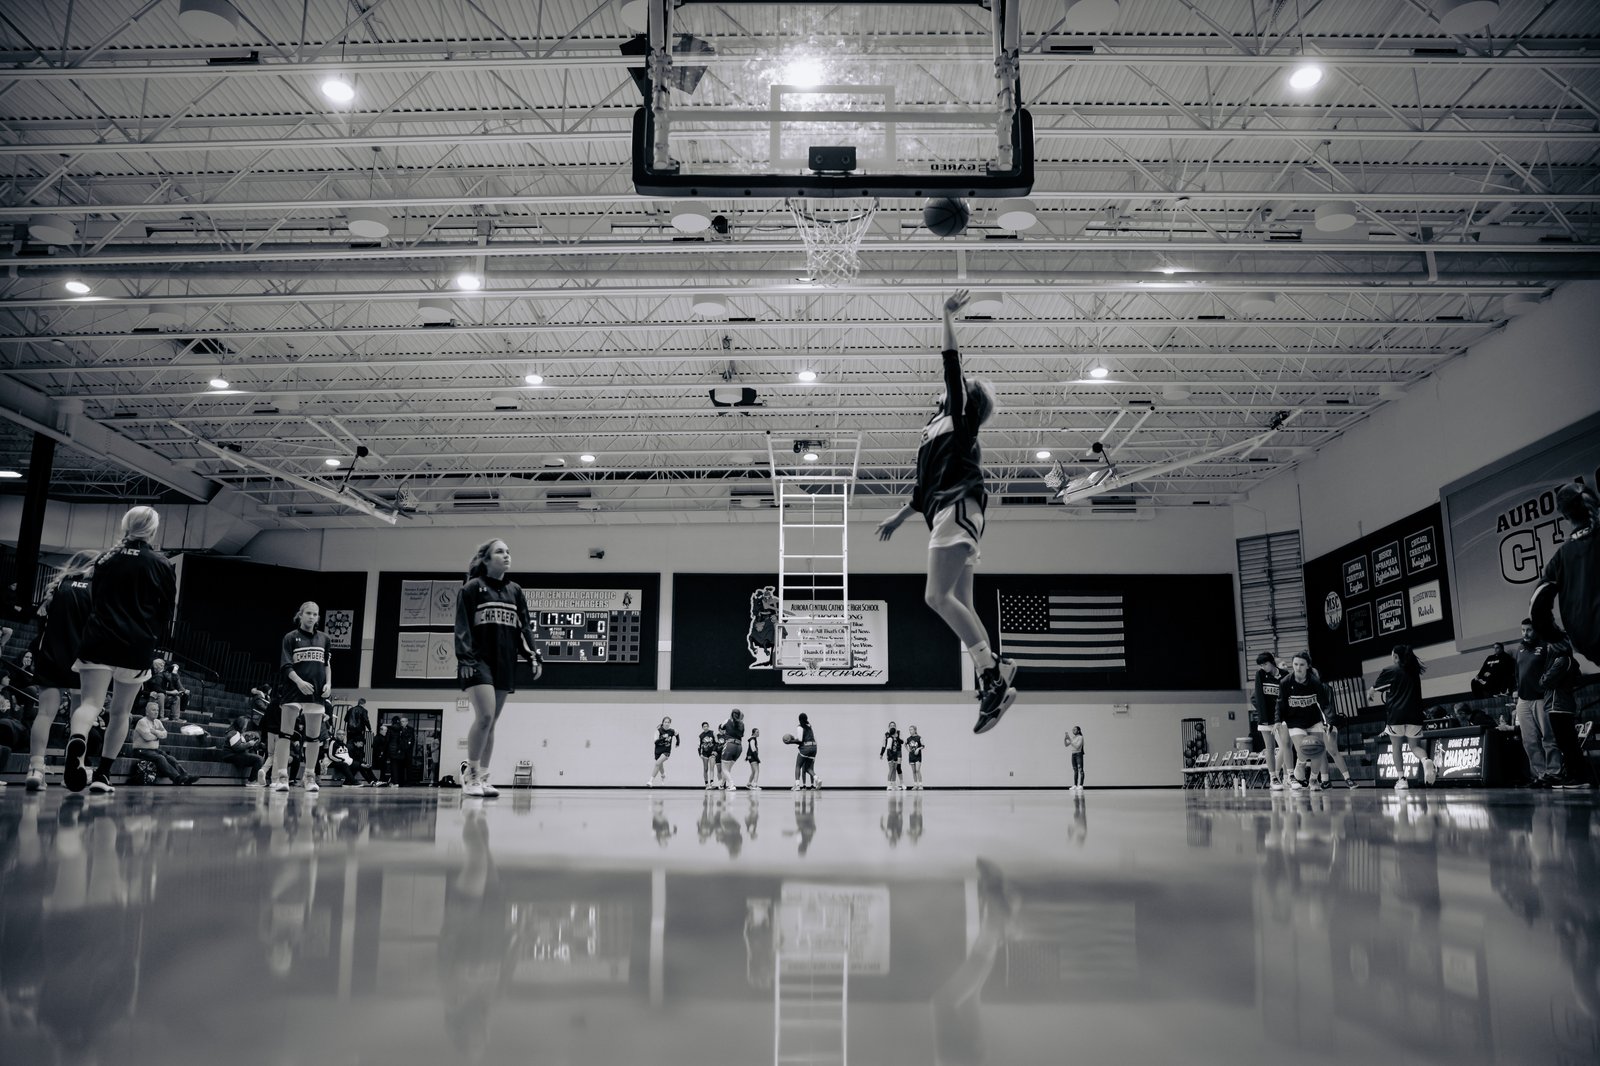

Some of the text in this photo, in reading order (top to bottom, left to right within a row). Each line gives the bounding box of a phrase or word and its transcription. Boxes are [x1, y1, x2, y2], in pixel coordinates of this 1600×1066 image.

[1411, 535, 1428, 548] CHICAGO
[1409, 542, 1431, 557] CHRISTIAN
[547, 590, 579, 600] CENTRAL
[580, 590, 616, 600] CATHOLIC
[527, 599, 609, 608] OME OF THE CHARGERS
[790, 603, 808, 611] AURORA
[808, 603, 827, 611] CENTRAL
[850, 603, 862, 611] HIGH
[862, 603, 880, 611] SCHOOL
[480, 610, 515, 624] CHARGER
[547, 613, 582, 625] 17:40
[597, 620, 605, 633] 0
[598, 646, 605, 657] 0
[1447, 736, 1481, 748] HOME OF THE
[1444, 747, 1482, 767] CHARGERS
